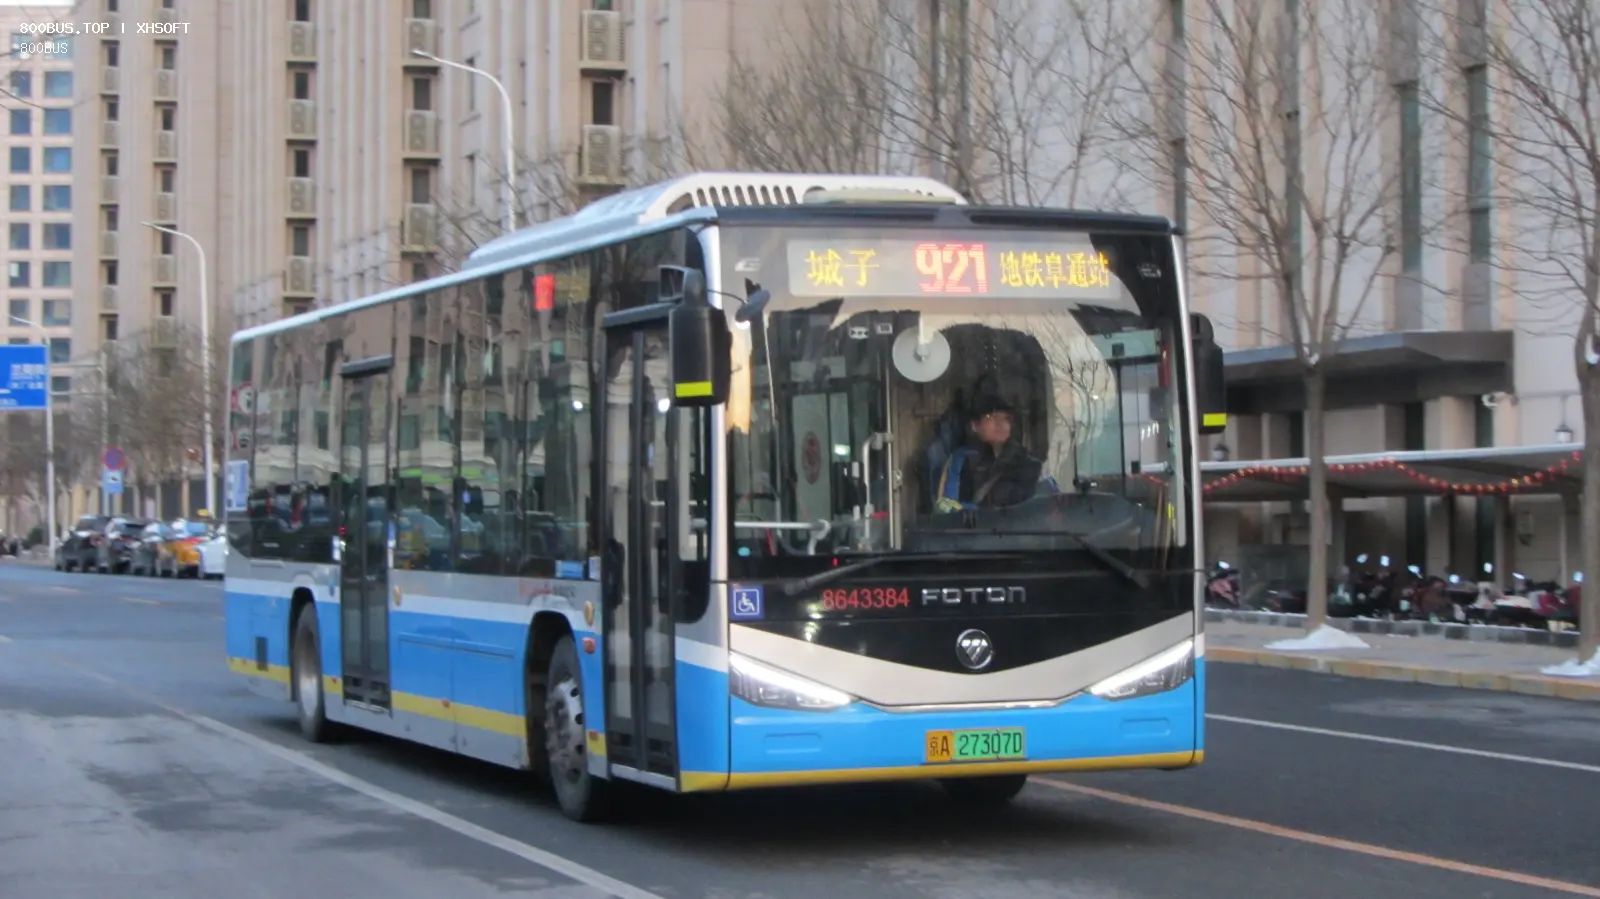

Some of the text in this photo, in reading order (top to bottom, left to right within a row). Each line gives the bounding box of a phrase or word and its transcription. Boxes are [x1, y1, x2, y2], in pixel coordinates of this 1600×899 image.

[805, 242, 1110, 293] 城子 921 地铁阜通站
[822, 588, 909, 609] 8643384
[921, 586, 1026, 605] FOTON
[958, 732, 1022, 757] 27307D
